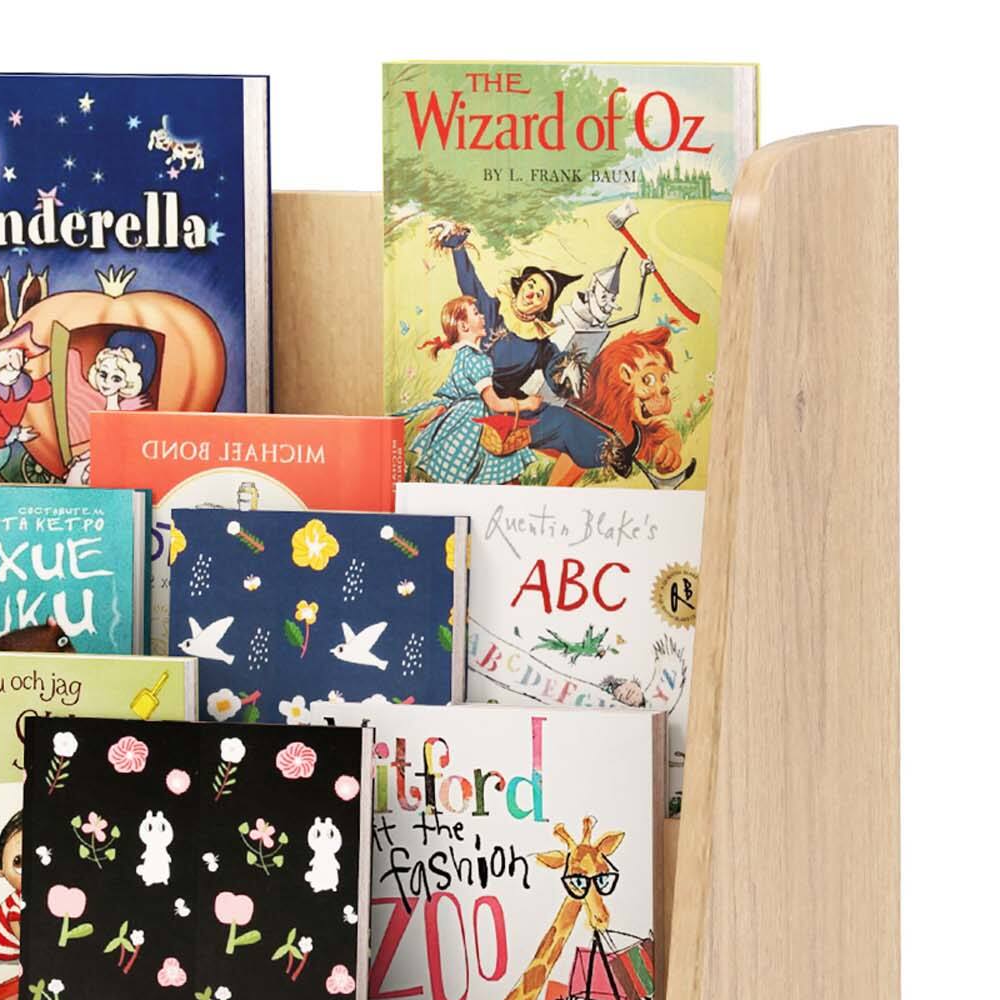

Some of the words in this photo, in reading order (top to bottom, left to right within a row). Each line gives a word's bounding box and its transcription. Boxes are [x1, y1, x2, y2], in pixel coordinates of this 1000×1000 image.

[465, 72, 531, 94] THE
[403, 90, 567, 151] Wizard
[575, 87, 628, 151] of
[634, 90, 715, 154] Oz
[483, 168, 503, 182] BY
[509, 168, 523, 182] L.
[530, 168, 585, 183] FRANK
[591, 168, 637, 184] BAUM
[35, 517, 105, 532] КЕТРО
[484, 503, 569, 560] Quentin
[568, 508, 658, 547] Blake's
[510, 558, 631, 614] ABC
[10, 670, 45, 691] och
[39, 672, 82, 706] jag
[372, 716, 550, 823] itford
[412, 810, 465, 846] the
[379, 834, 531, 914] fashion
